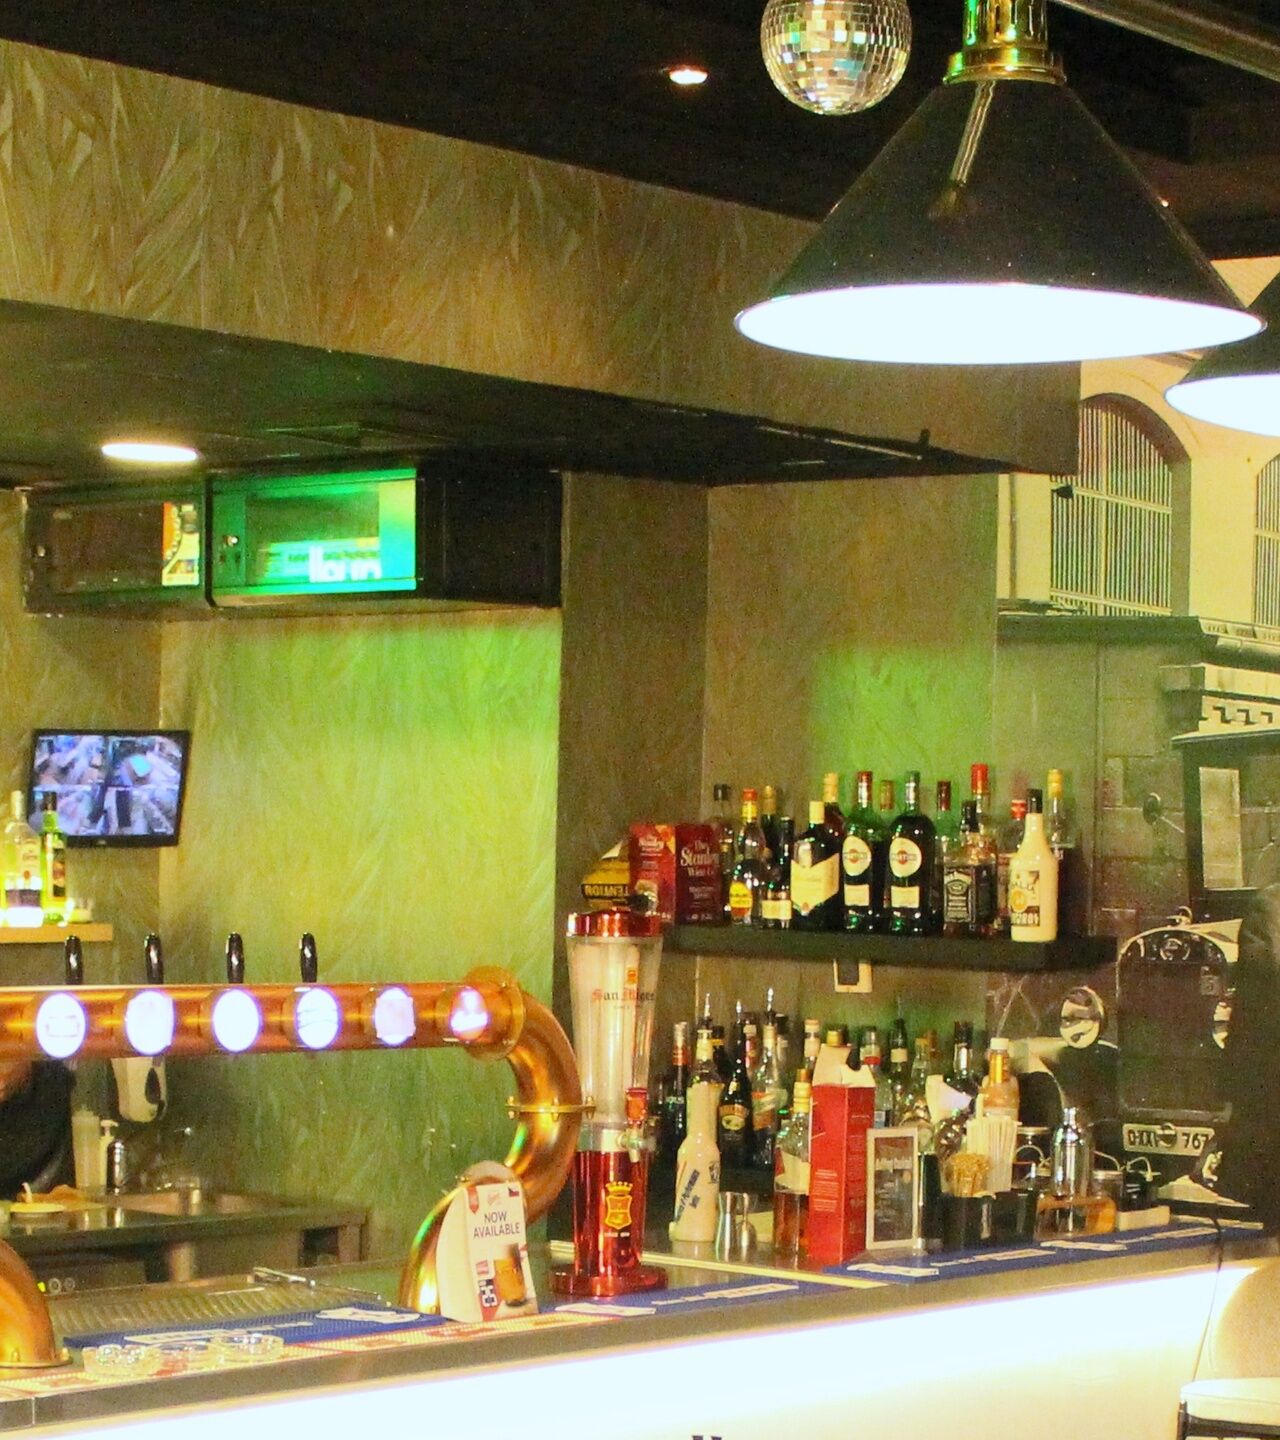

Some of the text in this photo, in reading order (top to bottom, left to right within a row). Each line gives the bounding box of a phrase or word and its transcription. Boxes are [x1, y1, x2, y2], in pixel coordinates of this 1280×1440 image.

[584, 885, 629, 897] TENTION
[484, 1211, 507, 1223] NOW
[473, 1222, 520, 1239] AVAILABLE
